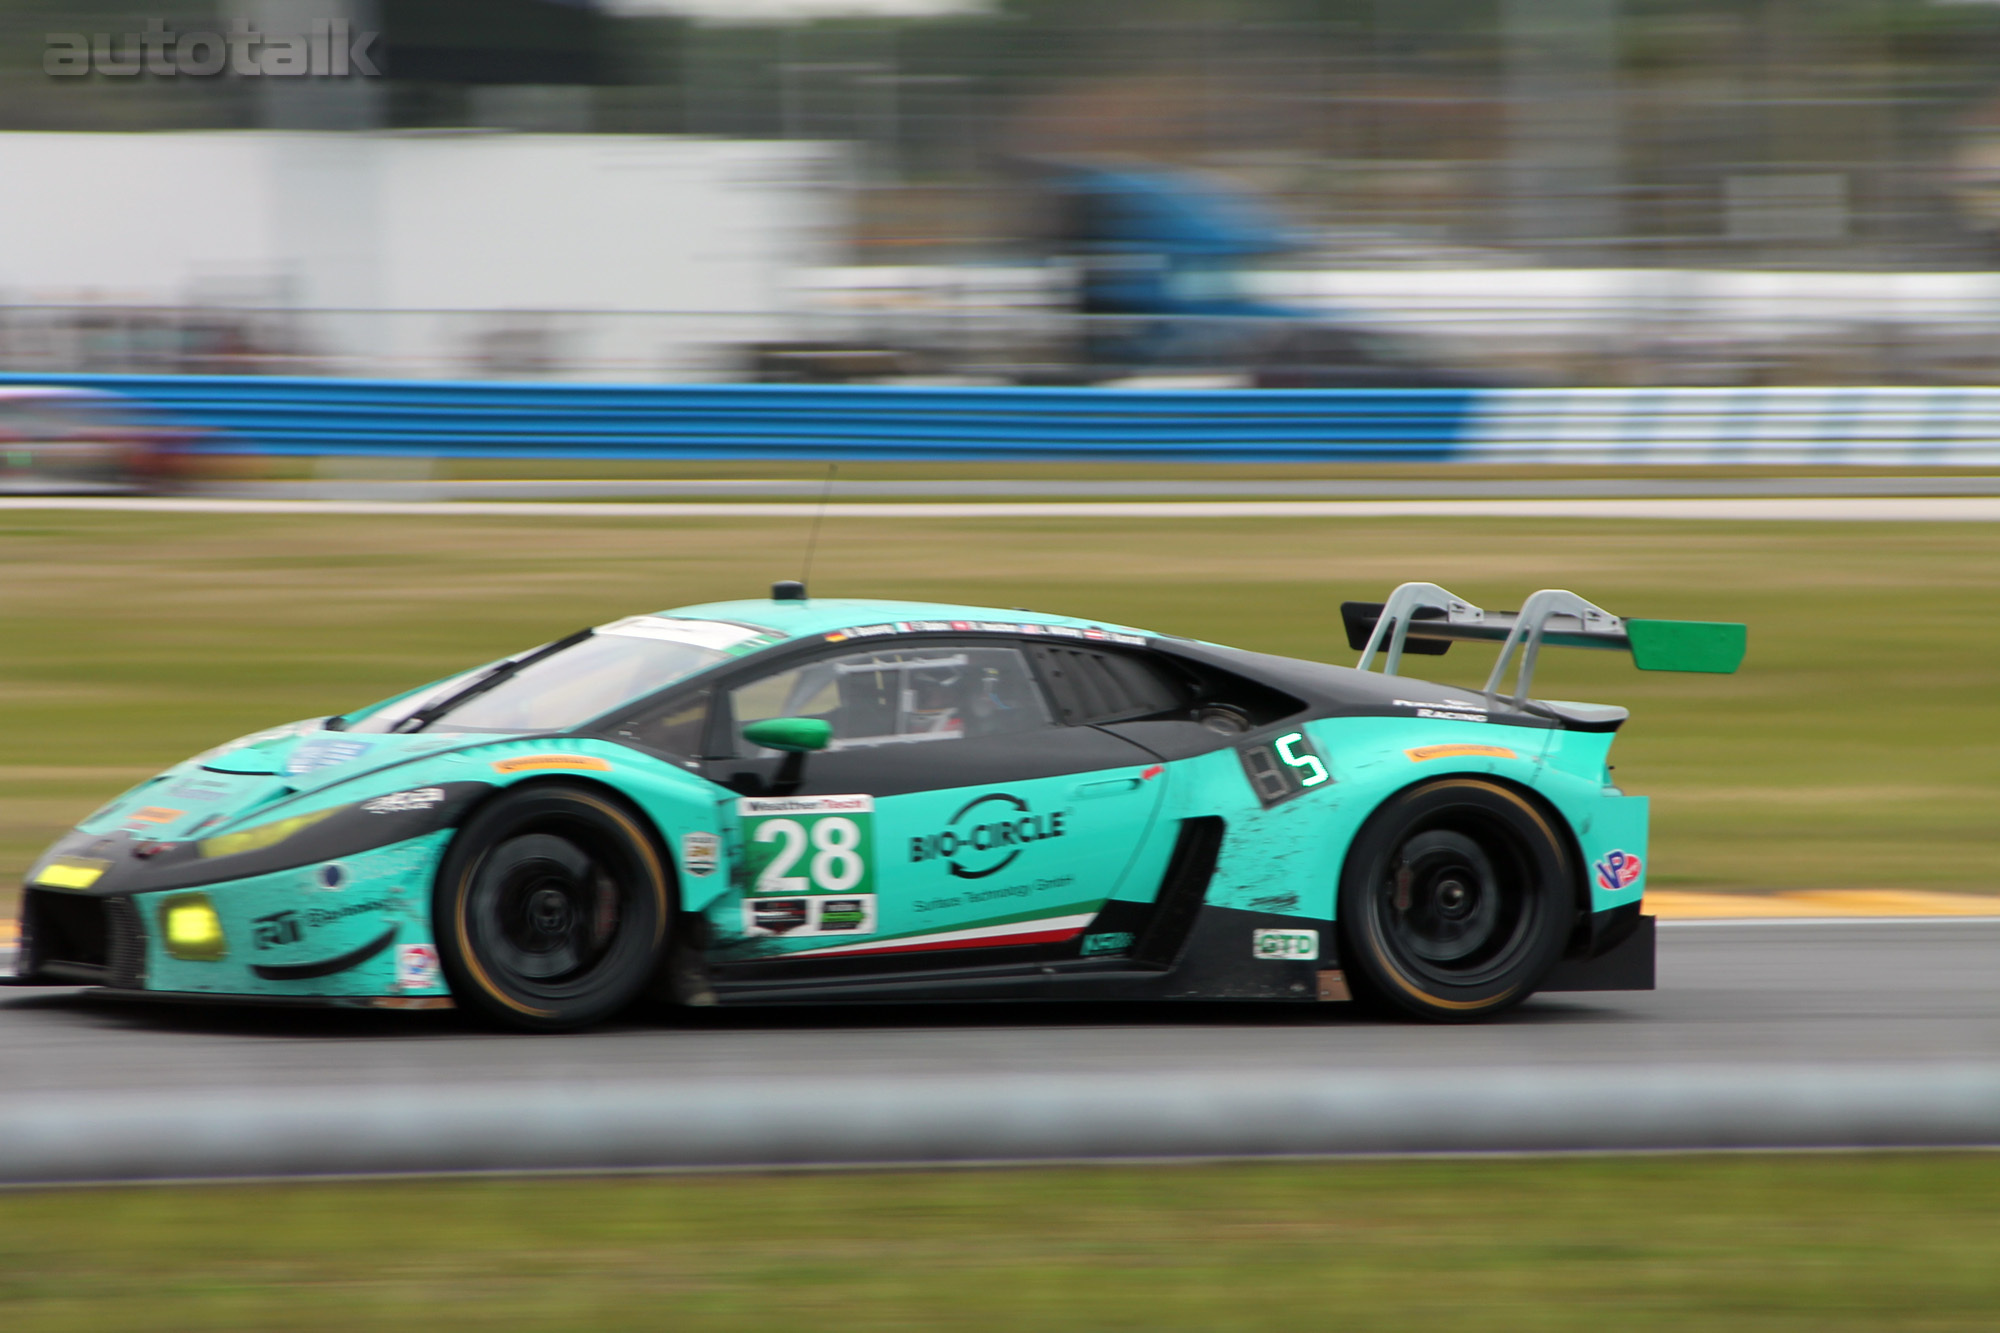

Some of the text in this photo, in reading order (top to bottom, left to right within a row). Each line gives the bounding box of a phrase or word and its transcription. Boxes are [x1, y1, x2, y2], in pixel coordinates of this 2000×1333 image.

[1417, 708, 1488, 722] RACING
[1275, 733, 1329, 787] 5
[752, 816, 865, 893] 28
[909, 811, 1066, 862] BIO-CIRCLE
[1596, 850, 1625, 890] VP
[1258, 934, 1314, 954] GTD
